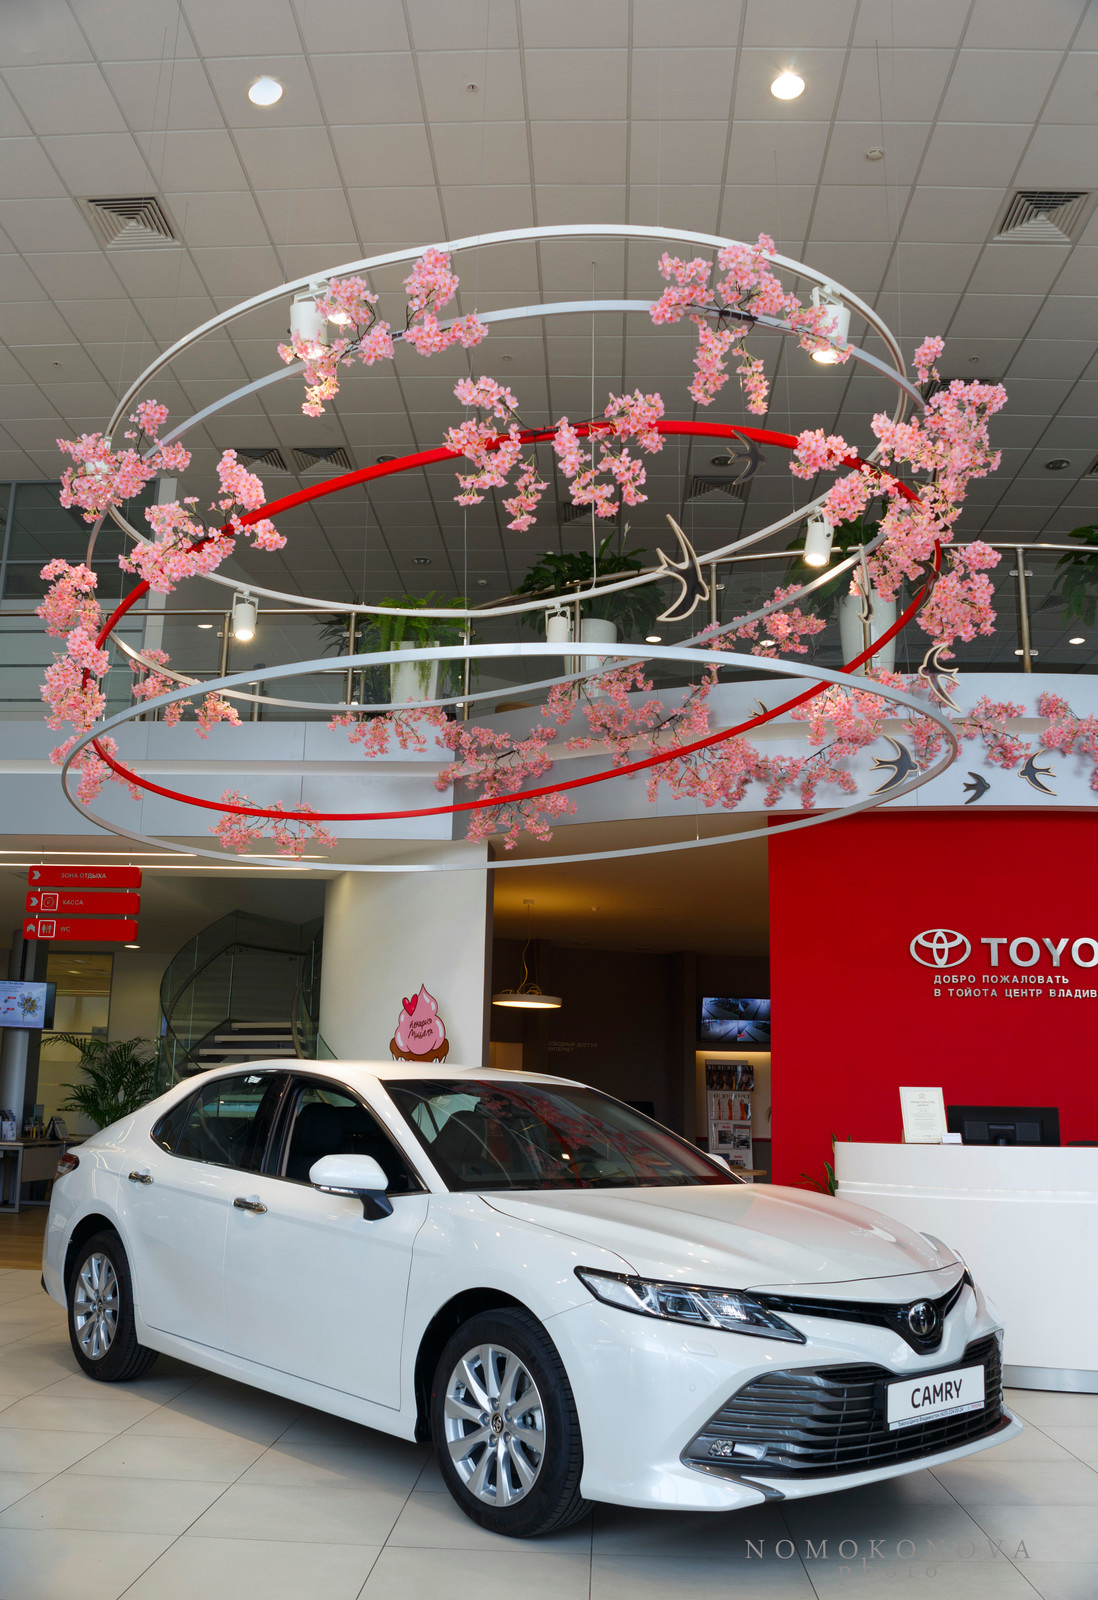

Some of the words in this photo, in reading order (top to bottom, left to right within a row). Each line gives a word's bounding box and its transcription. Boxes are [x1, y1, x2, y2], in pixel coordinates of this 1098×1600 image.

[933, 974, 976, 985] ДОБРО
[982, 974, 1070, 985] ПОЖАЛОВАТЬ
[933, 988, 942, 997] В
[948, 987, 998, 997] ТОЙОТА
[1005, 988, 1043, 998] ЦЕНТР
[911, 1378, 963, 1409] CAMRY
